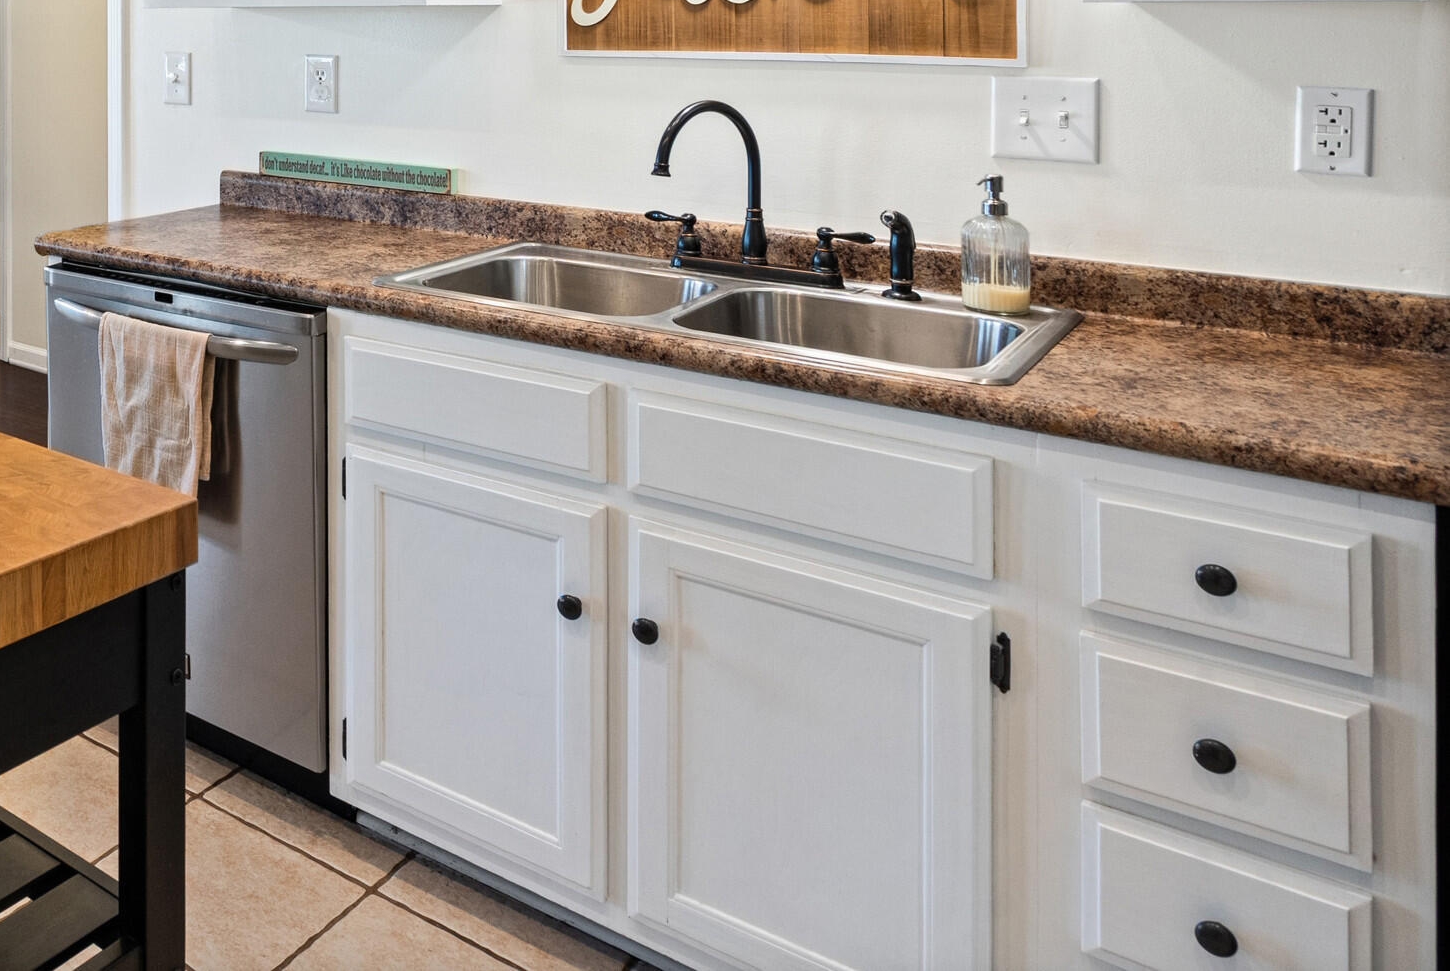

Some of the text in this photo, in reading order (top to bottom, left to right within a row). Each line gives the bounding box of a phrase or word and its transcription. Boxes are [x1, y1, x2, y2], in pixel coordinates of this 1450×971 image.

[278, 157, 309, 173] understand
[353, 164, 381, 181] chocolate
[381, 167, 405, 184] without
[405, 169, 416, 184] the
